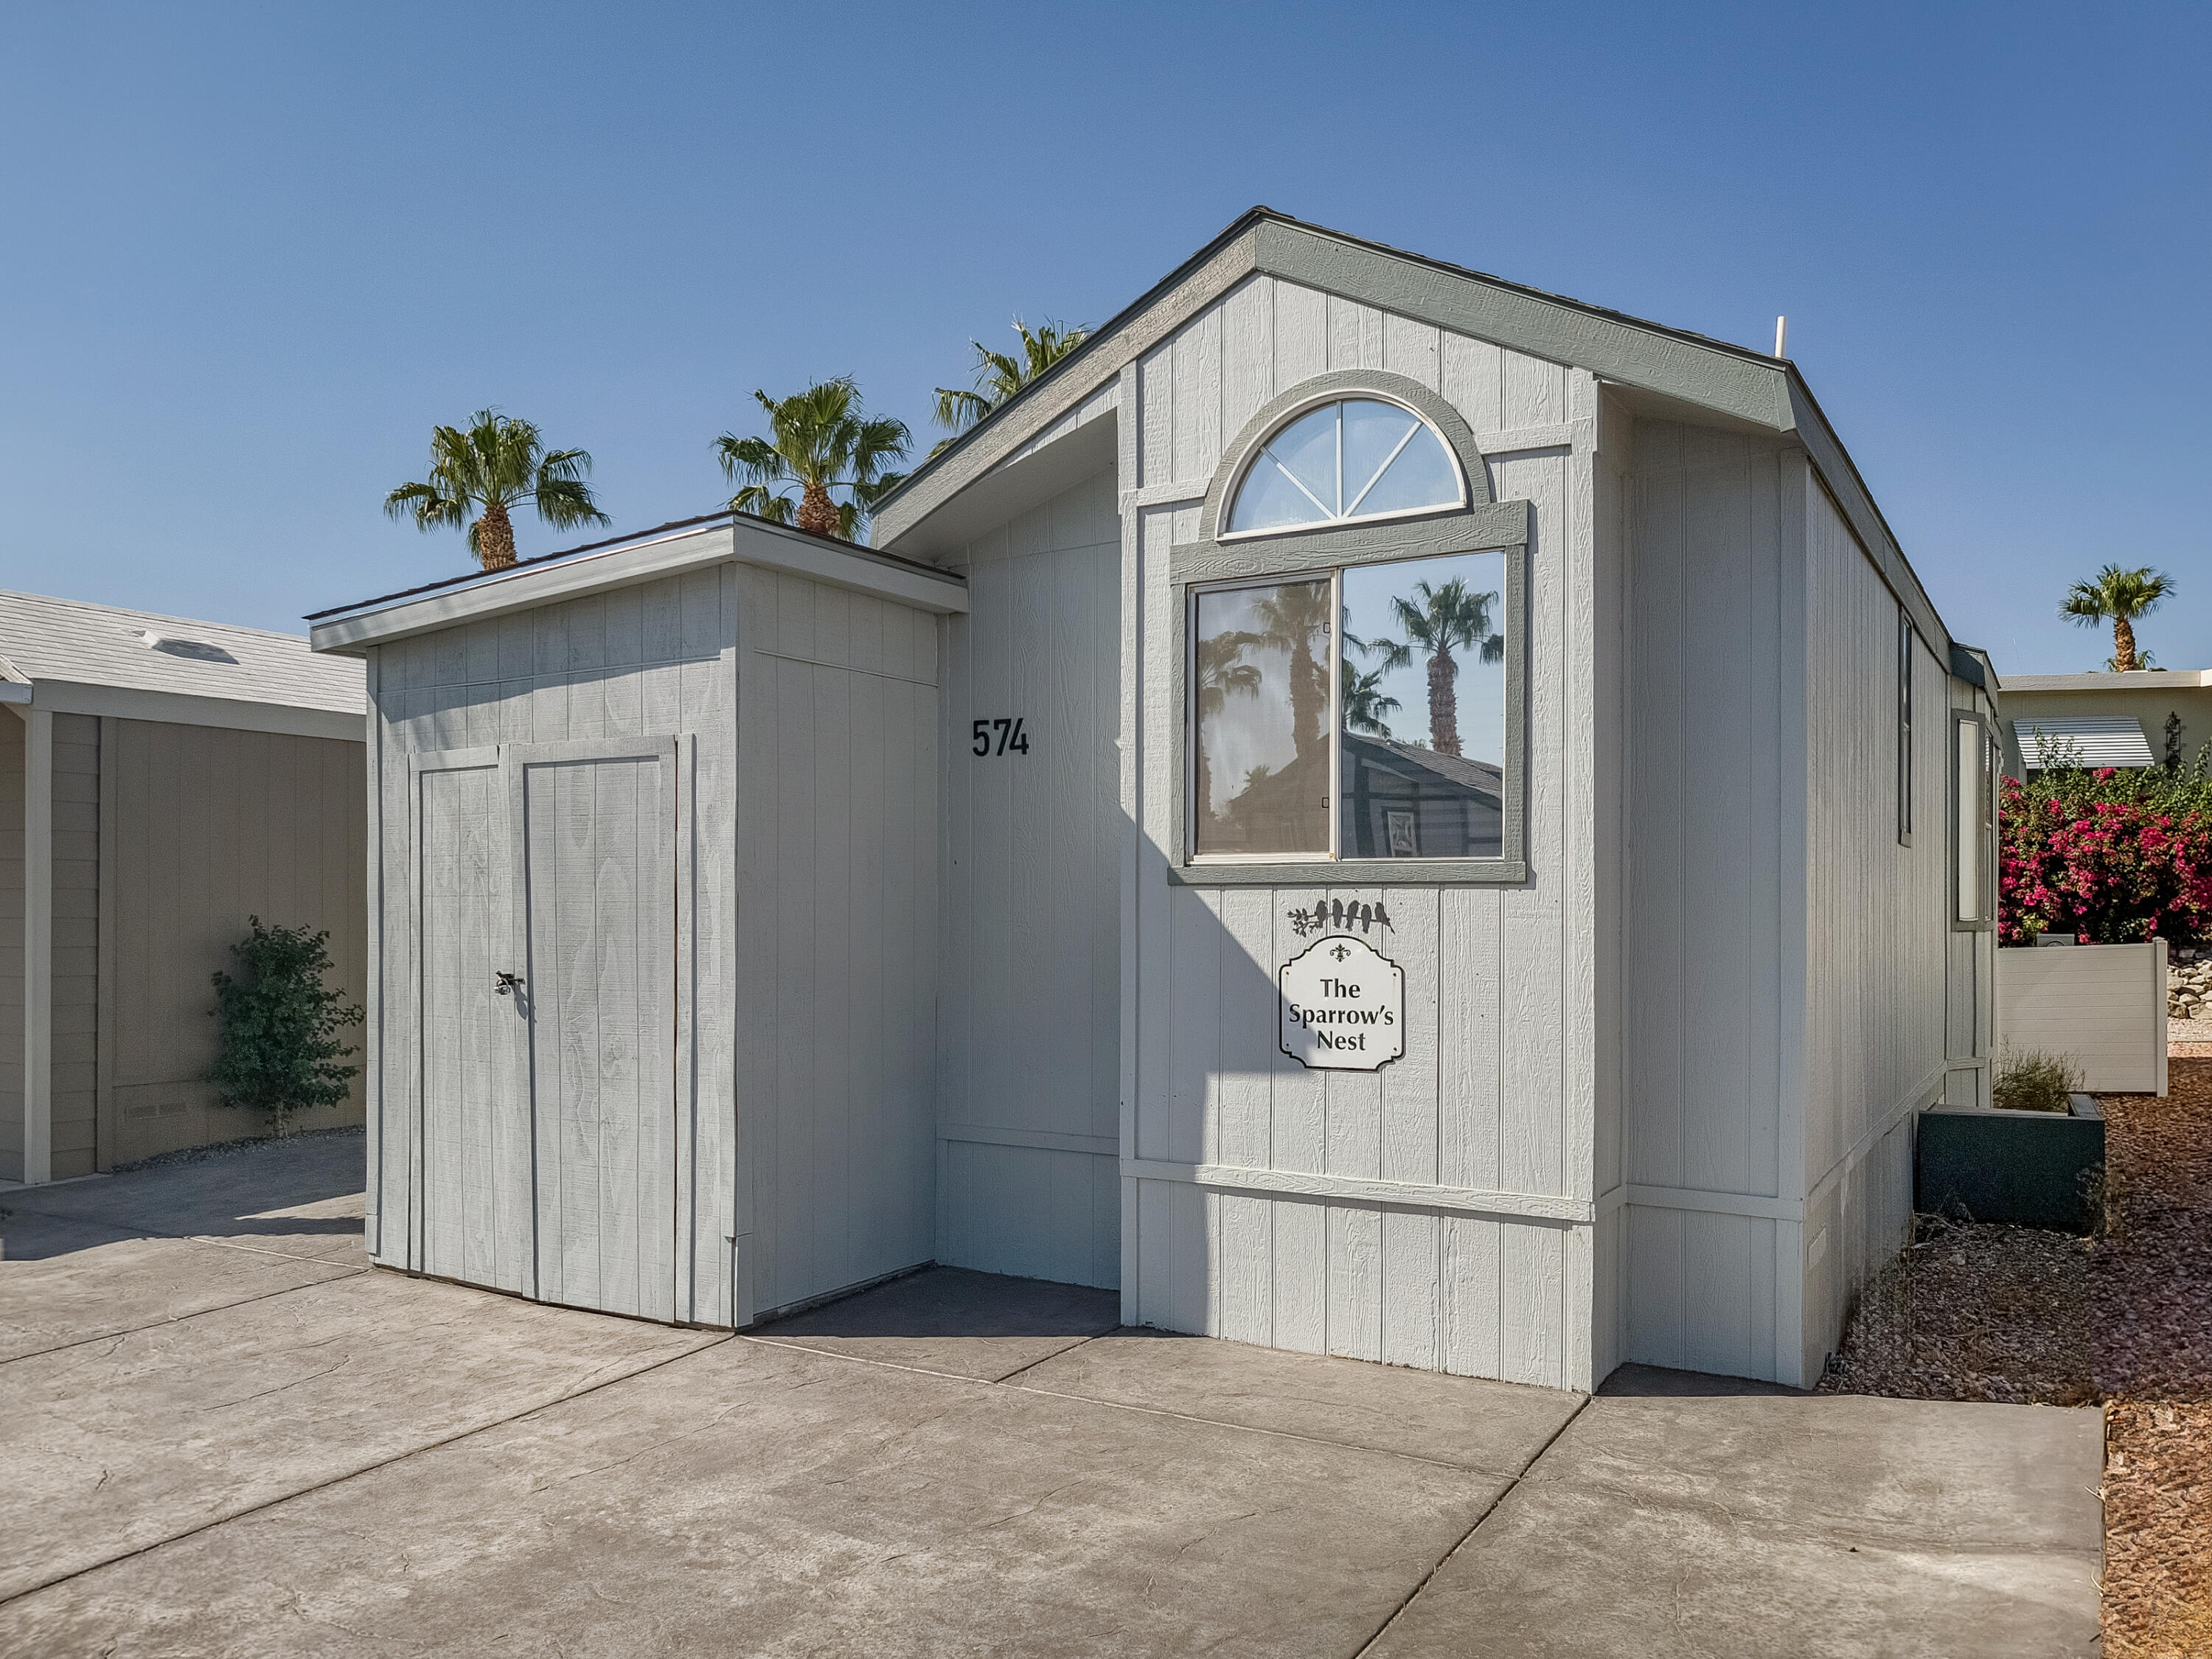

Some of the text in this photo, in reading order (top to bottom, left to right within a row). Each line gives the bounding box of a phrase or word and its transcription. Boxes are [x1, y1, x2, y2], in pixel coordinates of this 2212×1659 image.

[973, 717, 1029, 757] 574
[1320, 978, 1360, 998] The
[1289, 1004, 1394, 1029] Sparrow's
[1317, 1030, 1366, 1051] Nest
